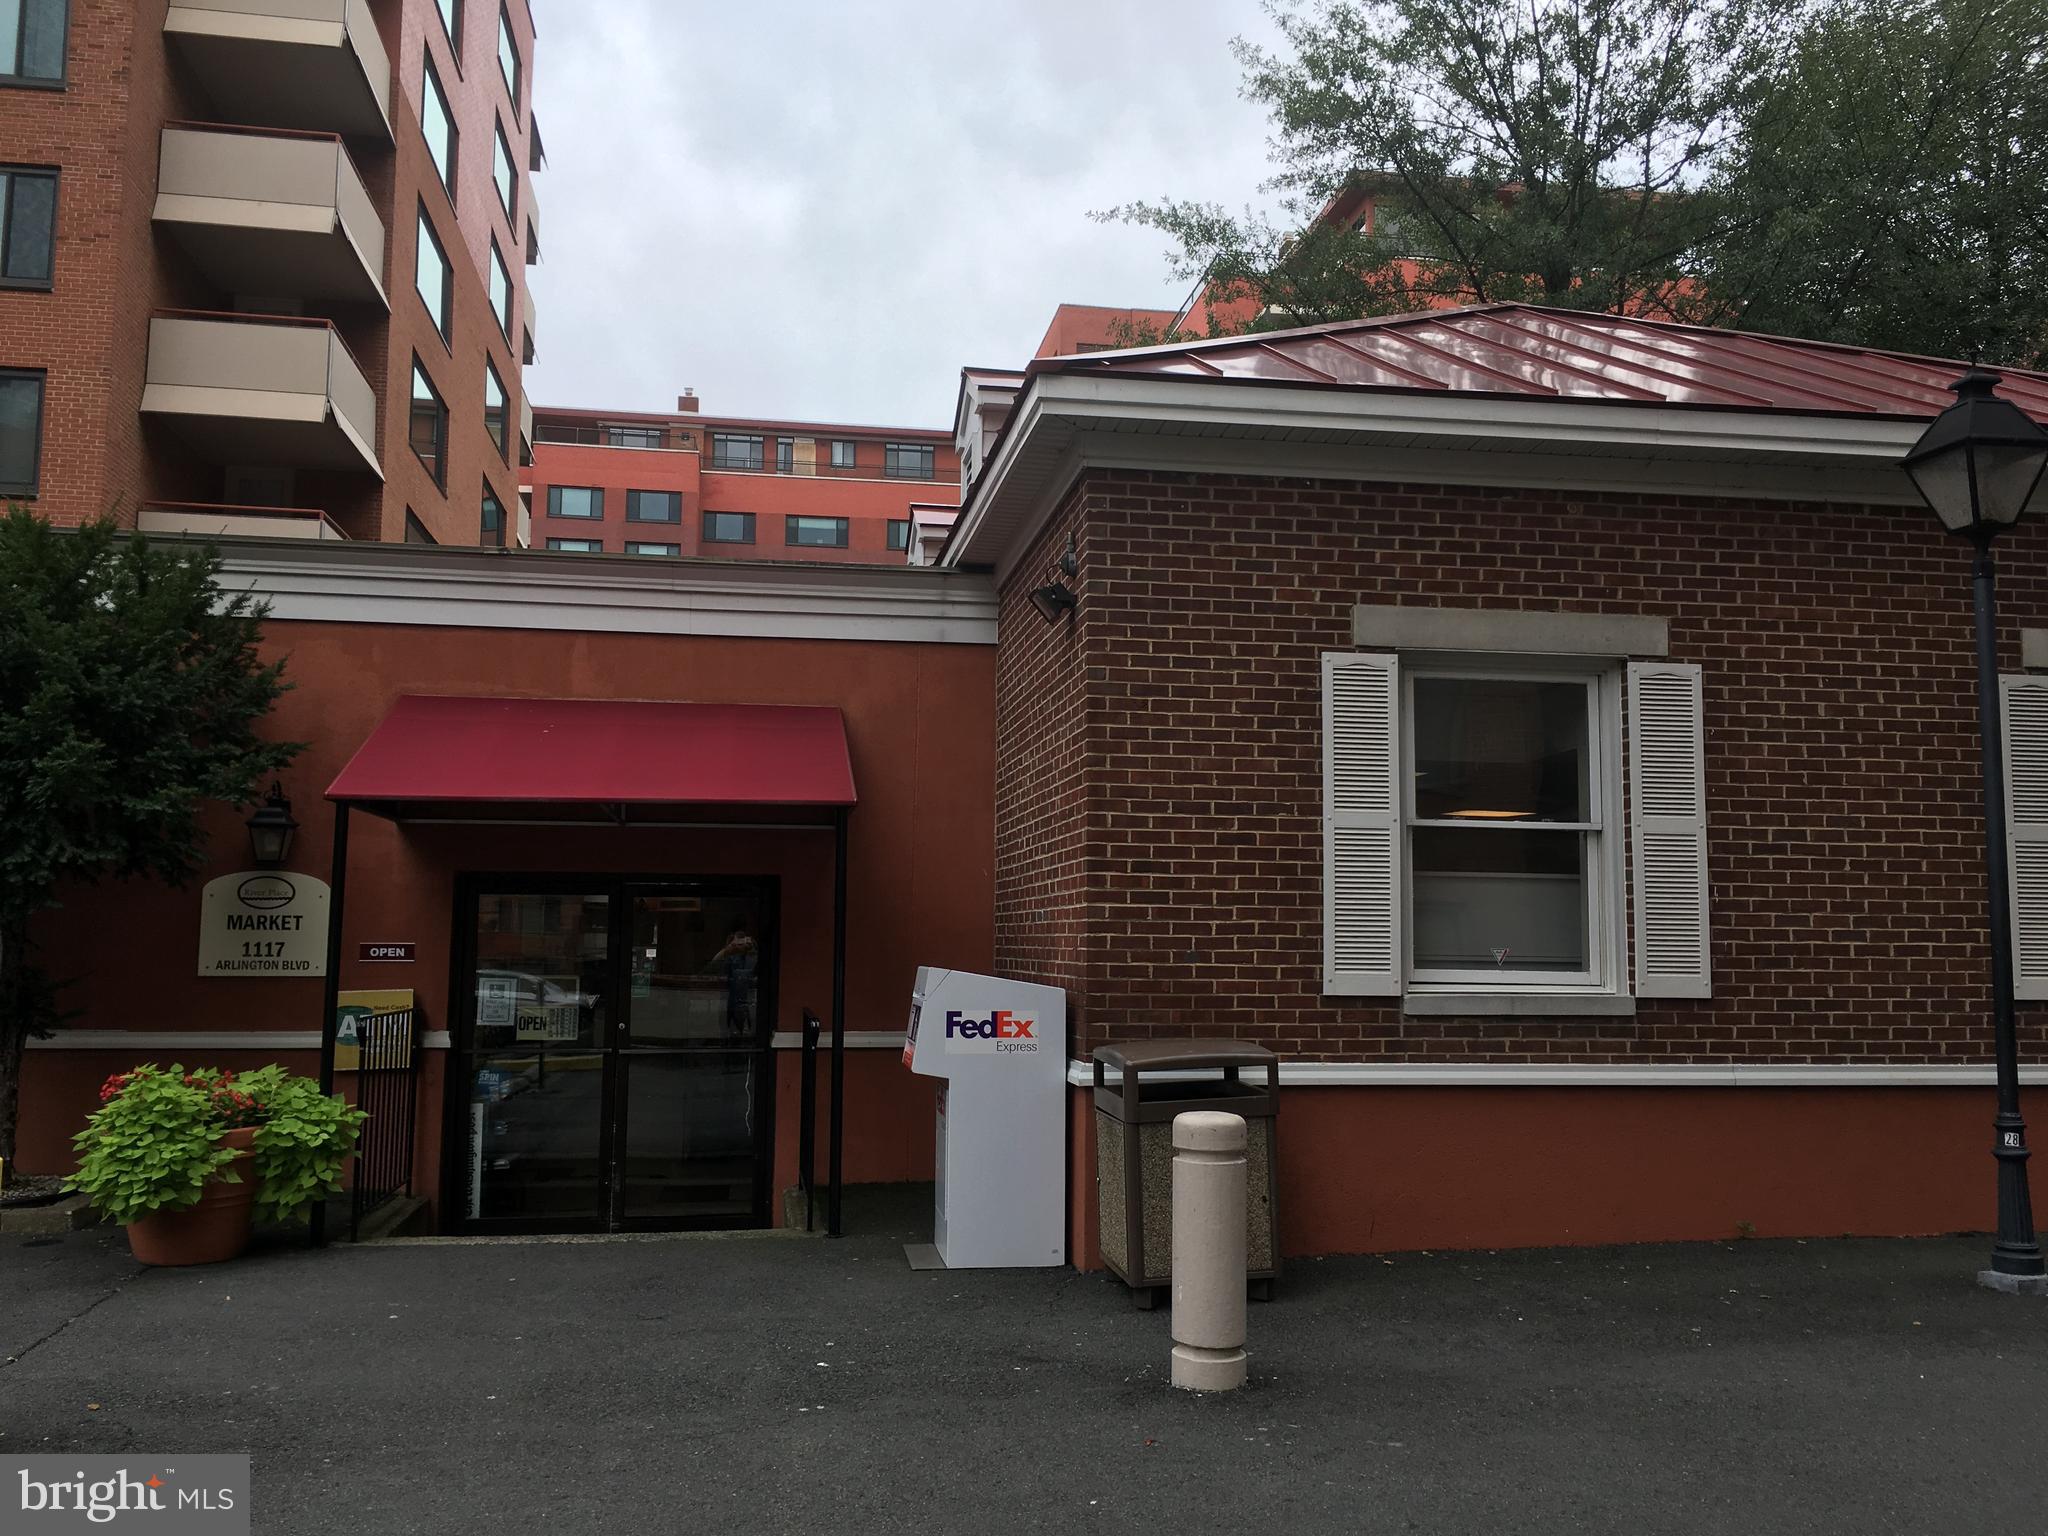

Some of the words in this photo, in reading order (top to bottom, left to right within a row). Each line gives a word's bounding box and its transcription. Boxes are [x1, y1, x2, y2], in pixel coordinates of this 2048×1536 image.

[227, 914, 303, 931] MARKET
[242, 941, 285, 958] 1117
[369, 947, 405, 957] OPEN
[215, 959, 279, 971] ARLINGTON
[281, 959, 310, 971] BLVD
[518, 1015, 547, 1031] OPEN
[946, 1010, 1034, 1039] FedEx
[996, 1040, 1038, 1054] Express
[2005, 1133, 2018, 1146] 28
